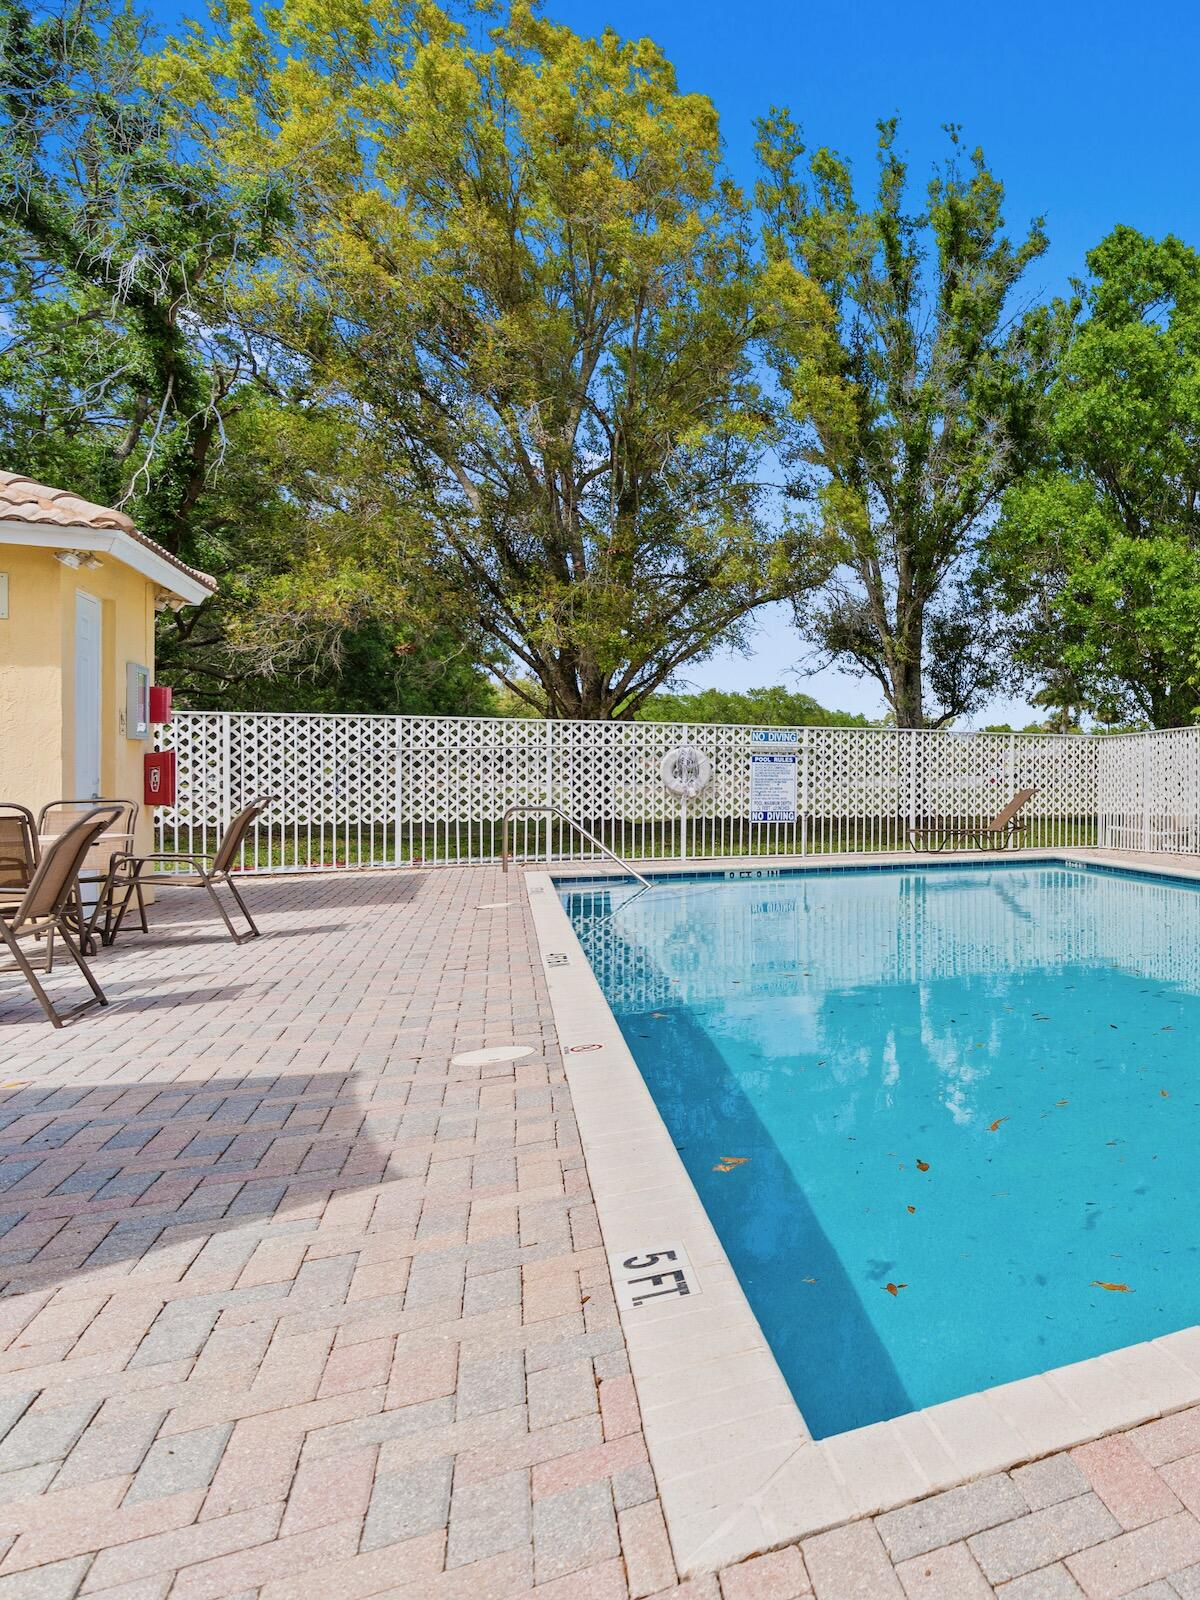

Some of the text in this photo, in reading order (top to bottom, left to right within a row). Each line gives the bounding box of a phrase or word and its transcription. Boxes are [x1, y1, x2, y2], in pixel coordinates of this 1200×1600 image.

[752, 732, 797, 742] NO DIVING
[752, 811, 794, 820] NO DIVING
[623, 1250, 678, 1269] 5
